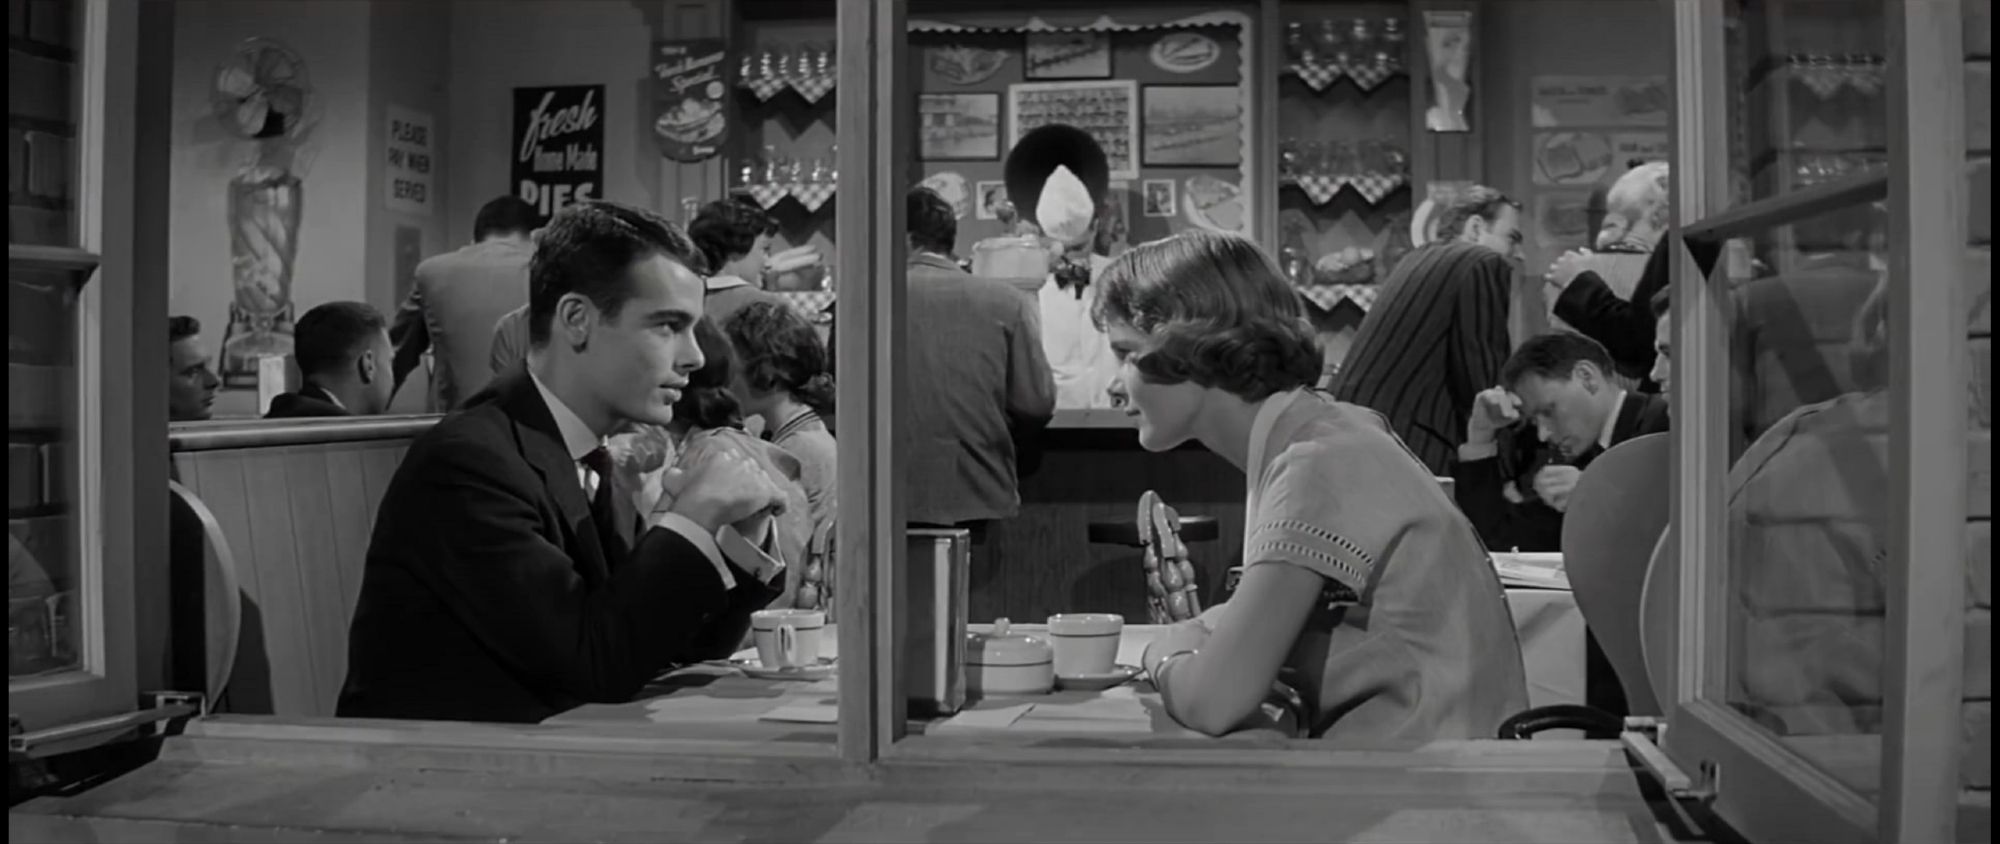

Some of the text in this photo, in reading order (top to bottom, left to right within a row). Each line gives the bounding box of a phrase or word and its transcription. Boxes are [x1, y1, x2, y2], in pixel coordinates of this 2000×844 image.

[518, 88, 599, 163] fresh
[532, 142, 598, 173] Home Made
